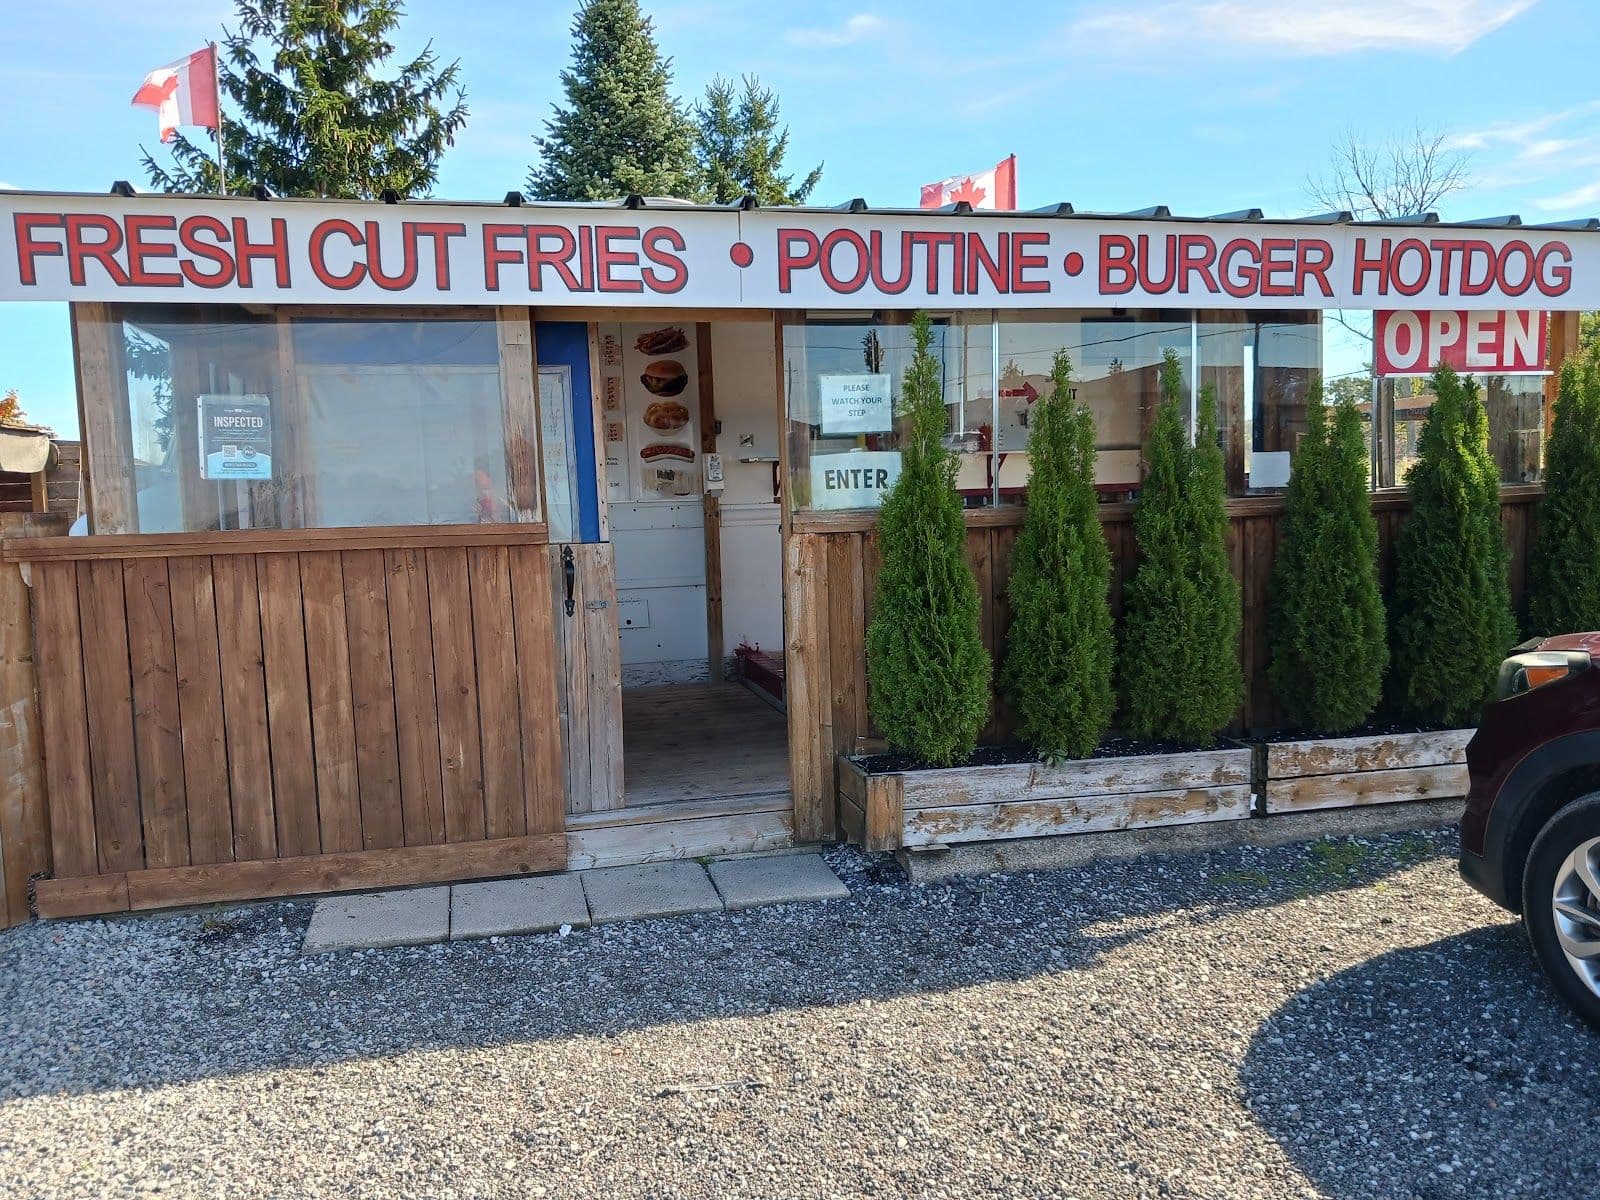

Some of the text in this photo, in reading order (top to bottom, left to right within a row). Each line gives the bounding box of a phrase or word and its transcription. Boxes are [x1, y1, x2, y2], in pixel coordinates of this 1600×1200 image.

[13, 212, 1572, 298] FRESH CUT FRIES POUTINE BURGER HOTDOG
[1384, 310, 1540, 369] OPEN
[843, 384, 870, 392] PLEASE
[861, 396, 882, 404] YOUR
[848, 409, 866, 417] STEP
[214, 416, 263, 428] INSPECTED
[824, 469, 888, 490] ENTER
